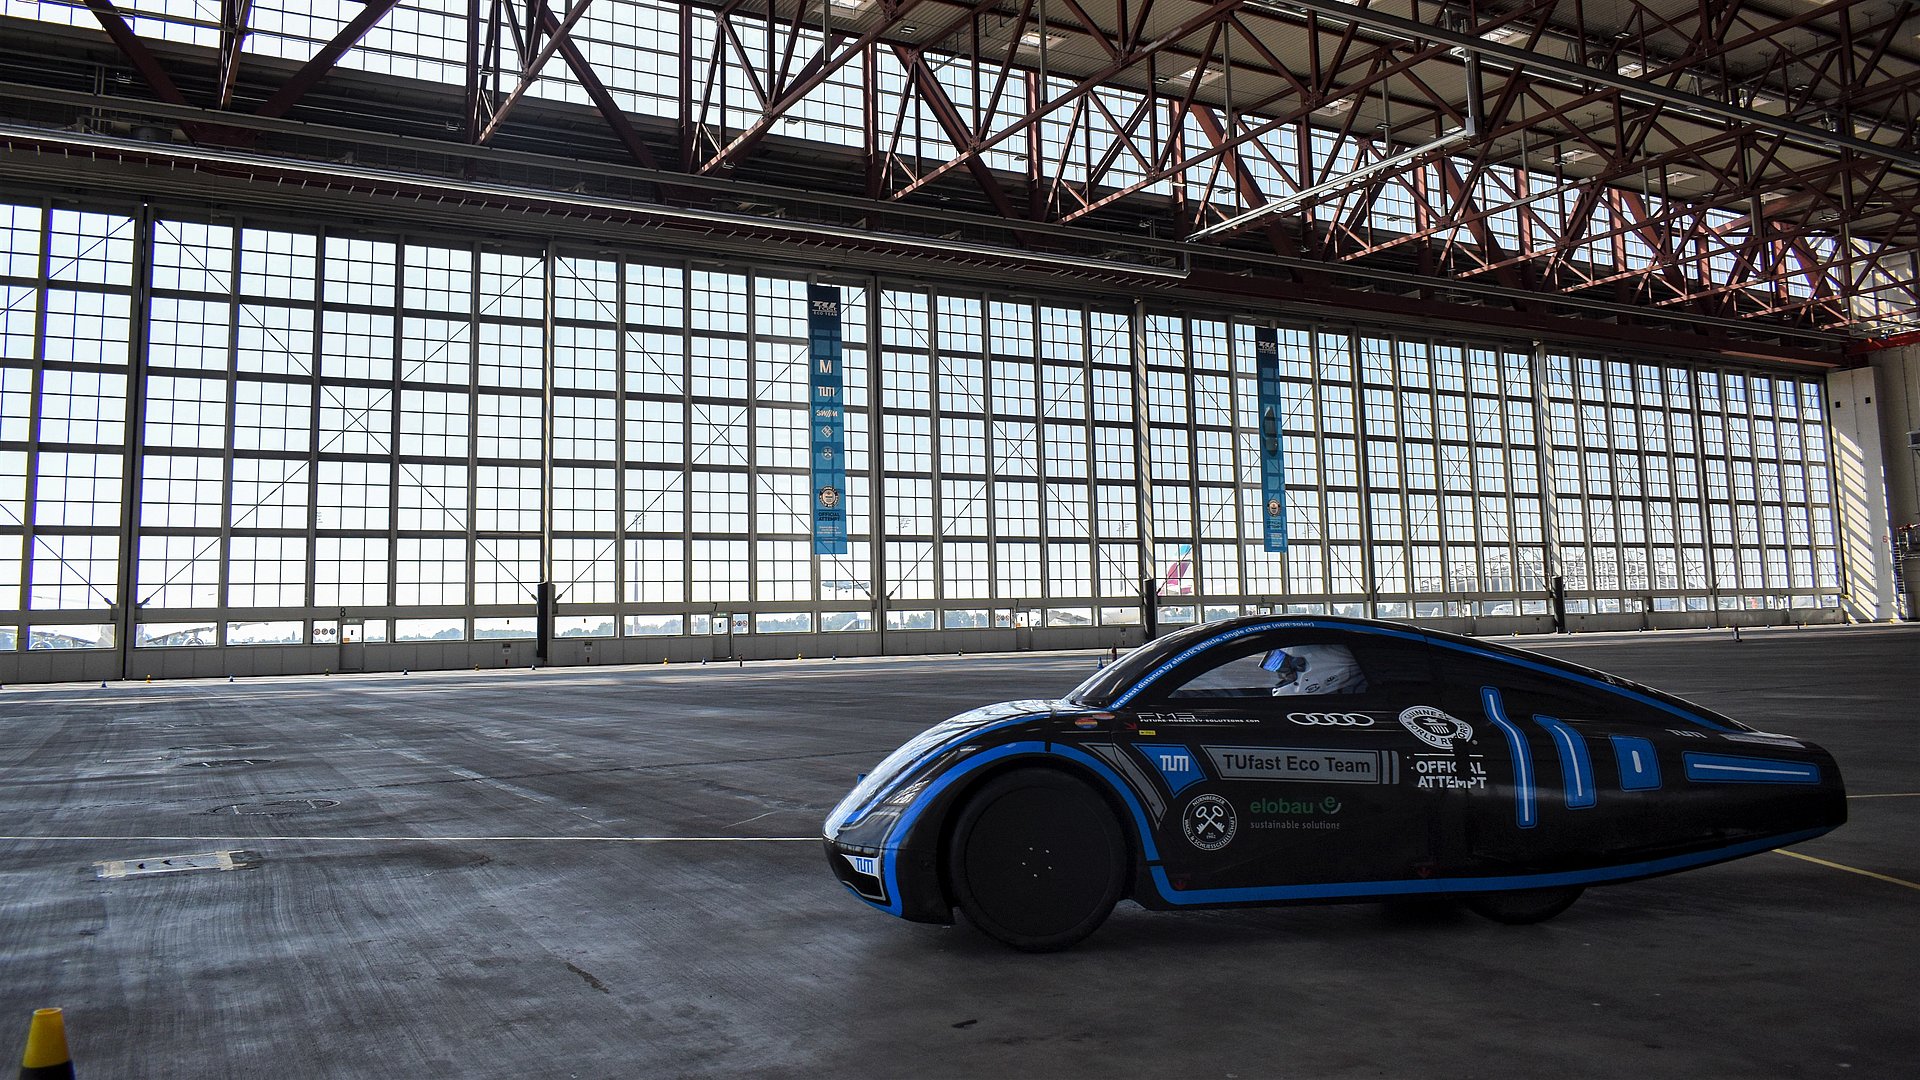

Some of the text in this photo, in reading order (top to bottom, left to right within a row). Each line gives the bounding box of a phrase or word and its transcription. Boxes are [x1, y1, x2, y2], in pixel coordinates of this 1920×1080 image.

[819, 359, 832, 374] M
[340, 606, 346, 617] 8
[1111, 620, 1315, 709] Greatest distance by electric vehicle, single charge (non-solar)
[1405, 721, 1437, 743] WORLD
[1159, 754, 1371, 773] TUM TUfast Eco Team
[1250, 798, 1314, 814] elobau
[1250, 820, 1341, 830] sustainable solutions
